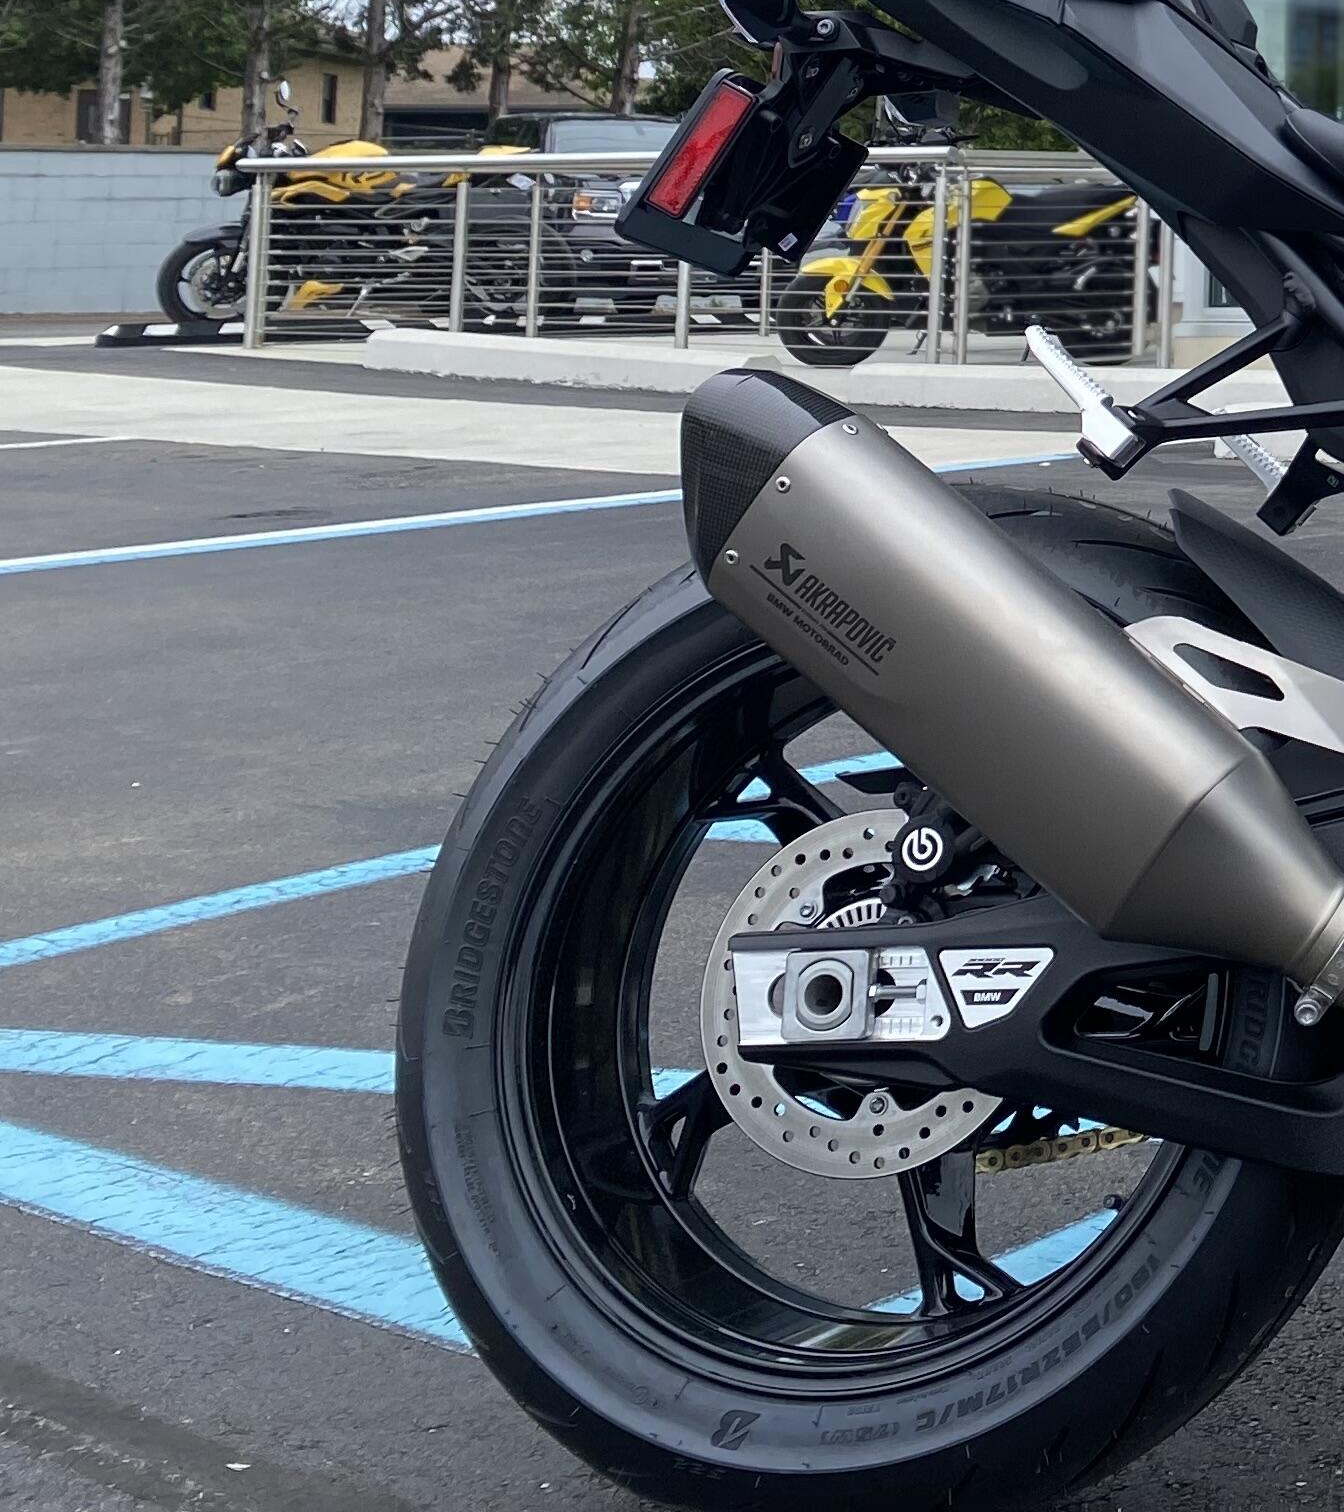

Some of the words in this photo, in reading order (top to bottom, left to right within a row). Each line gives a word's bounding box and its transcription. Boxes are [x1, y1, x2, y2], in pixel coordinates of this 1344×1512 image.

[766, 592, 794, 617] BMW
[793, 616, 849, 666] MOTORRAD
[441, 794, 543, 1041] BRIDGESTONE
[951, 959, 1042, 979] RR
[973, 992, 1002, 1003] BMW
